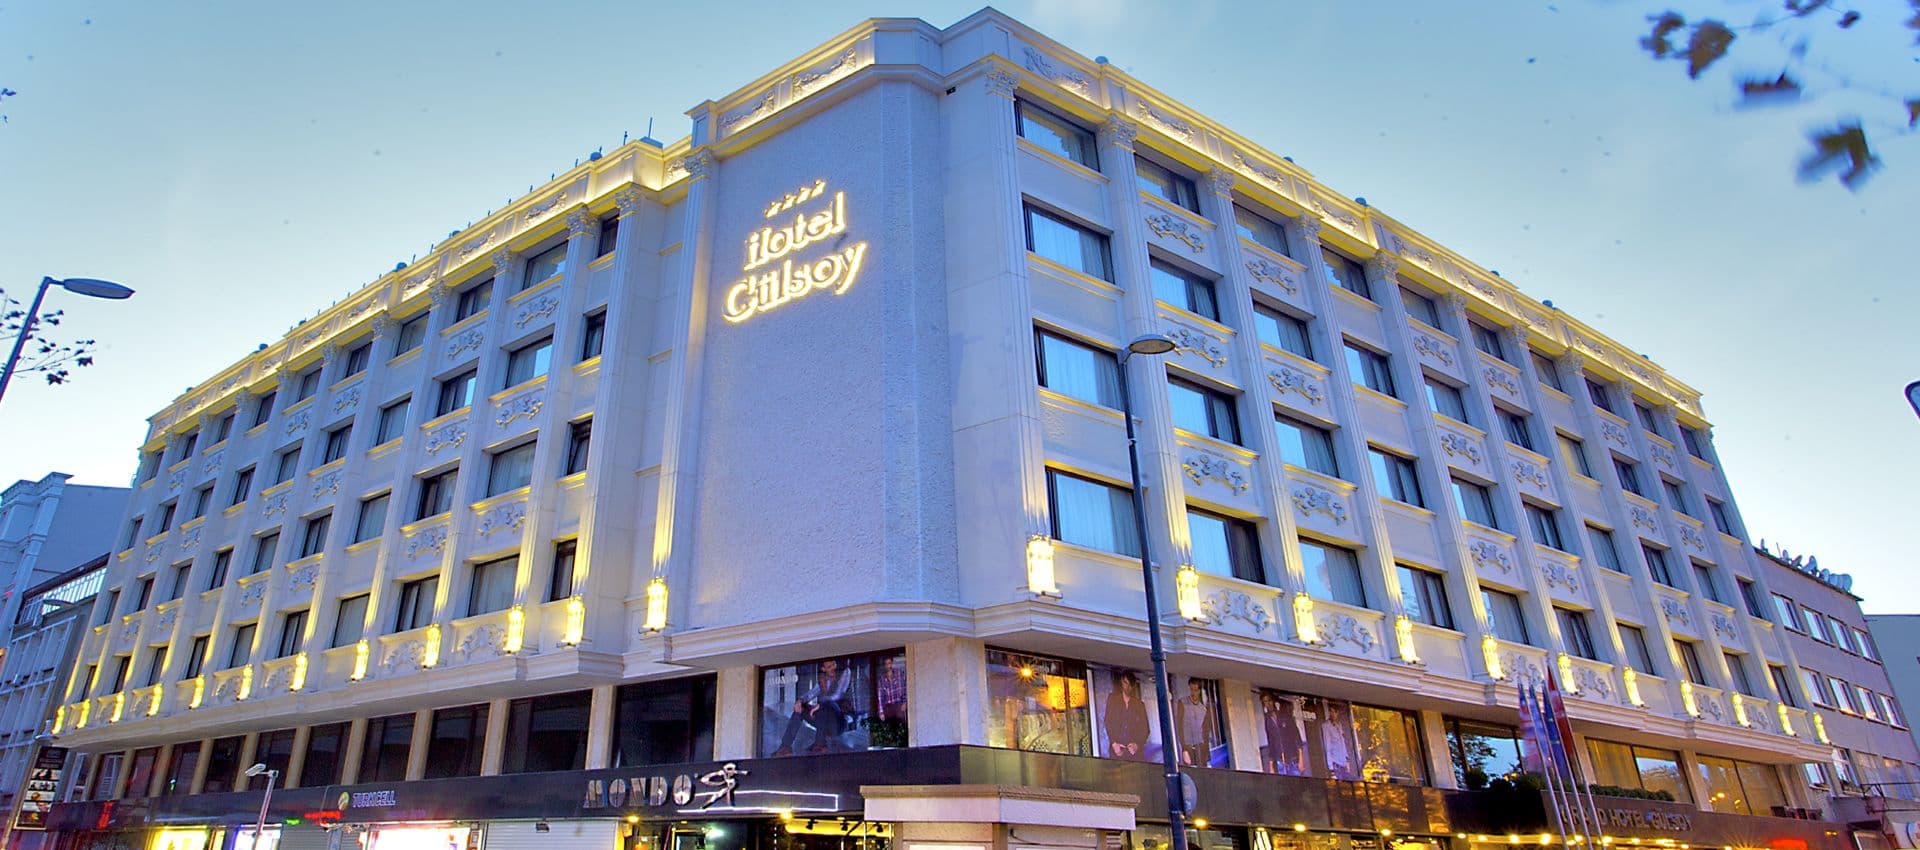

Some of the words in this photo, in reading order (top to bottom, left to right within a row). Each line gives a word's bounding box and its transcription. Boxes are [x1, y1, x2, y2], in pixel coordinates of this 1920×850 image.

[744, 191, 846, 271] Hotel
[352, 790, 396, 808] TURKCELL
[584, 773, 694, 809] MONDO
[1608, 808, 1650, 829] HOTEL
